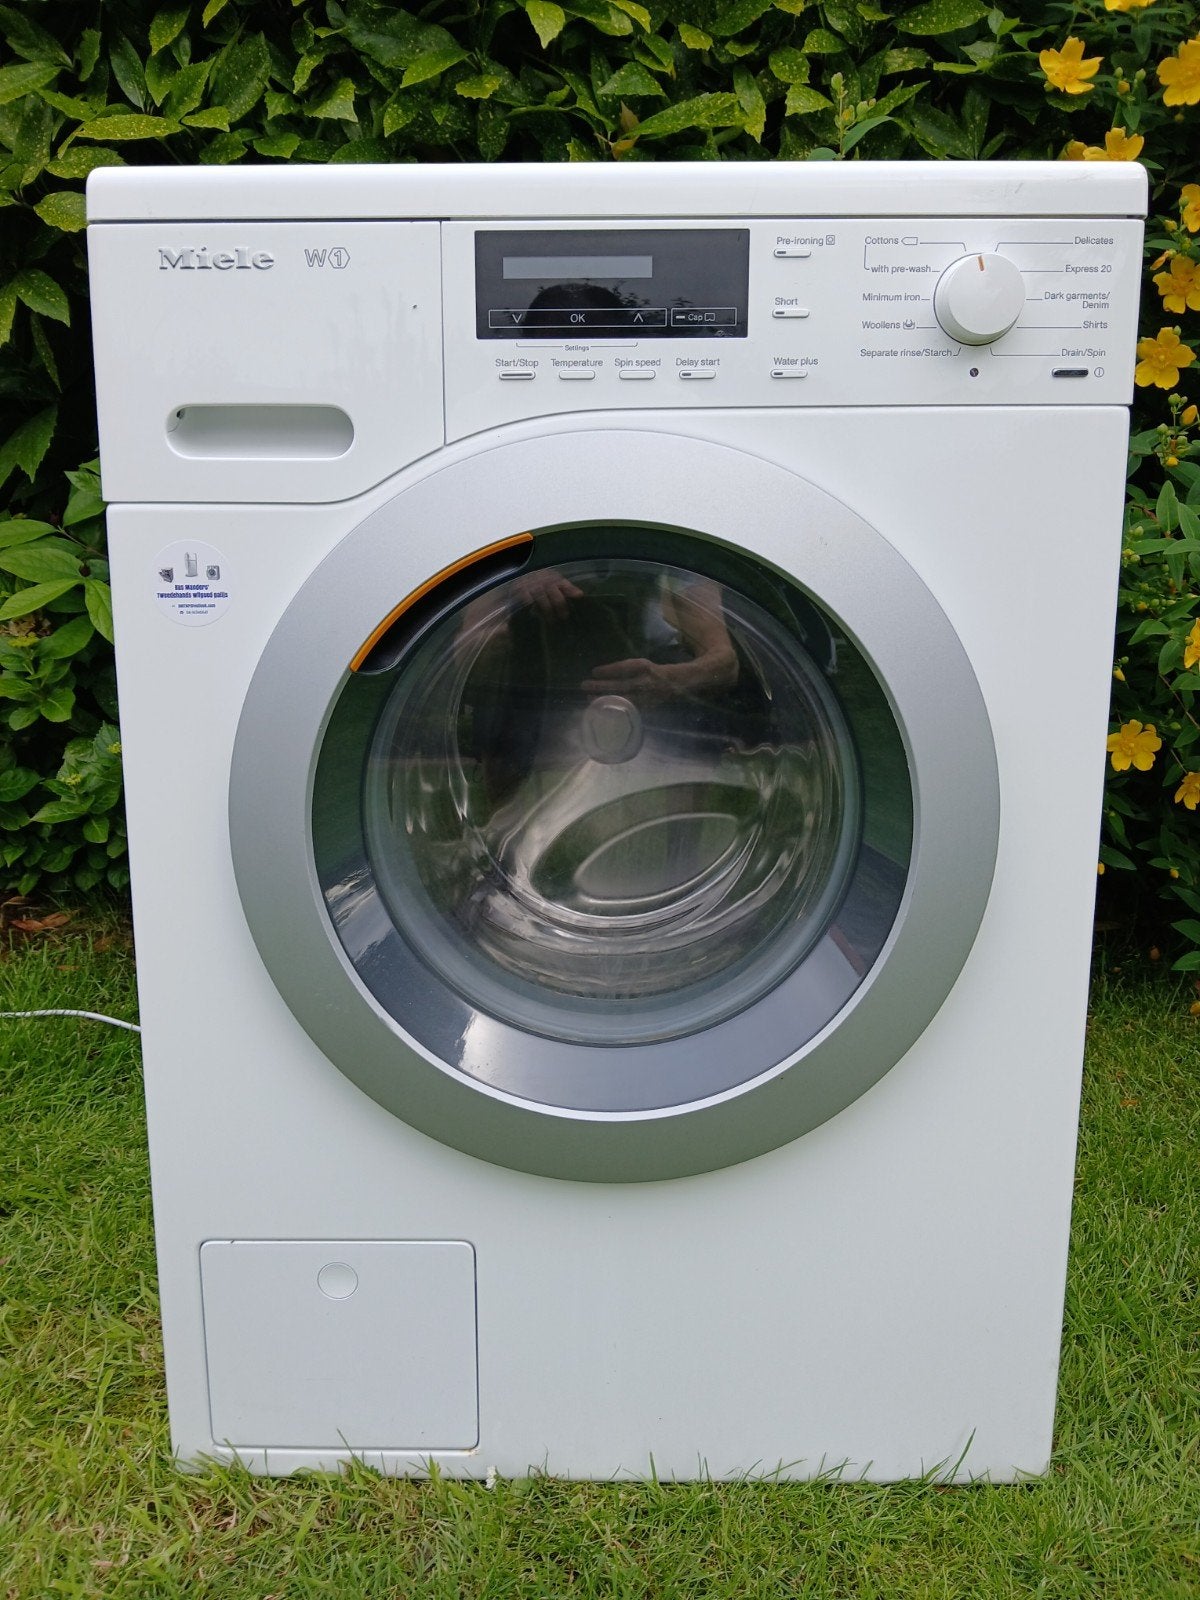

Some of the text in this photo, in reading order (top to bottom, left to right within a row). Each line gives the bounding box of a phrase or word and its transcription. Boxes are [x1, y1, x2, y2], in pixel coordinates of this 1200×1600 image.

[776, 236, 824, 246] Pre-ironing
[864, 236, 899, 246] Cottons
[1074, 236, 1114, 246] Delicates
[158, 247, 275, 271] Miele
[870, 265, 932, 275] with pre-wash
[1065, 265, 1113, 276] Express 20
[774, 297, 799, 306] Short
[862, 293, 921, 302] Minimum iron
[1044, 291, 1111, 302] Dark garments/
[1082, 301, 1110, 310] Denim
[570, 313, 586, 323] OK
[688, 313, 703, 322] Cap
[862, 320, 901, 330] Woollens
[1082, 320, 1108, 330] Shirts
[564, 344, 590, 352] Settings
[860, 348, 953, 358] Separate rinse/Starch
[1061, 348, 1107, 358] Drain/Spin
[495, 358, 539, 369] Start/Stop
[551, 358, 604, 369] Temperature
[614, 358, 662, 369] Spin speed
[675, 357, 721, 369] Delay start
[773, 357, 819, 368] Water plus
